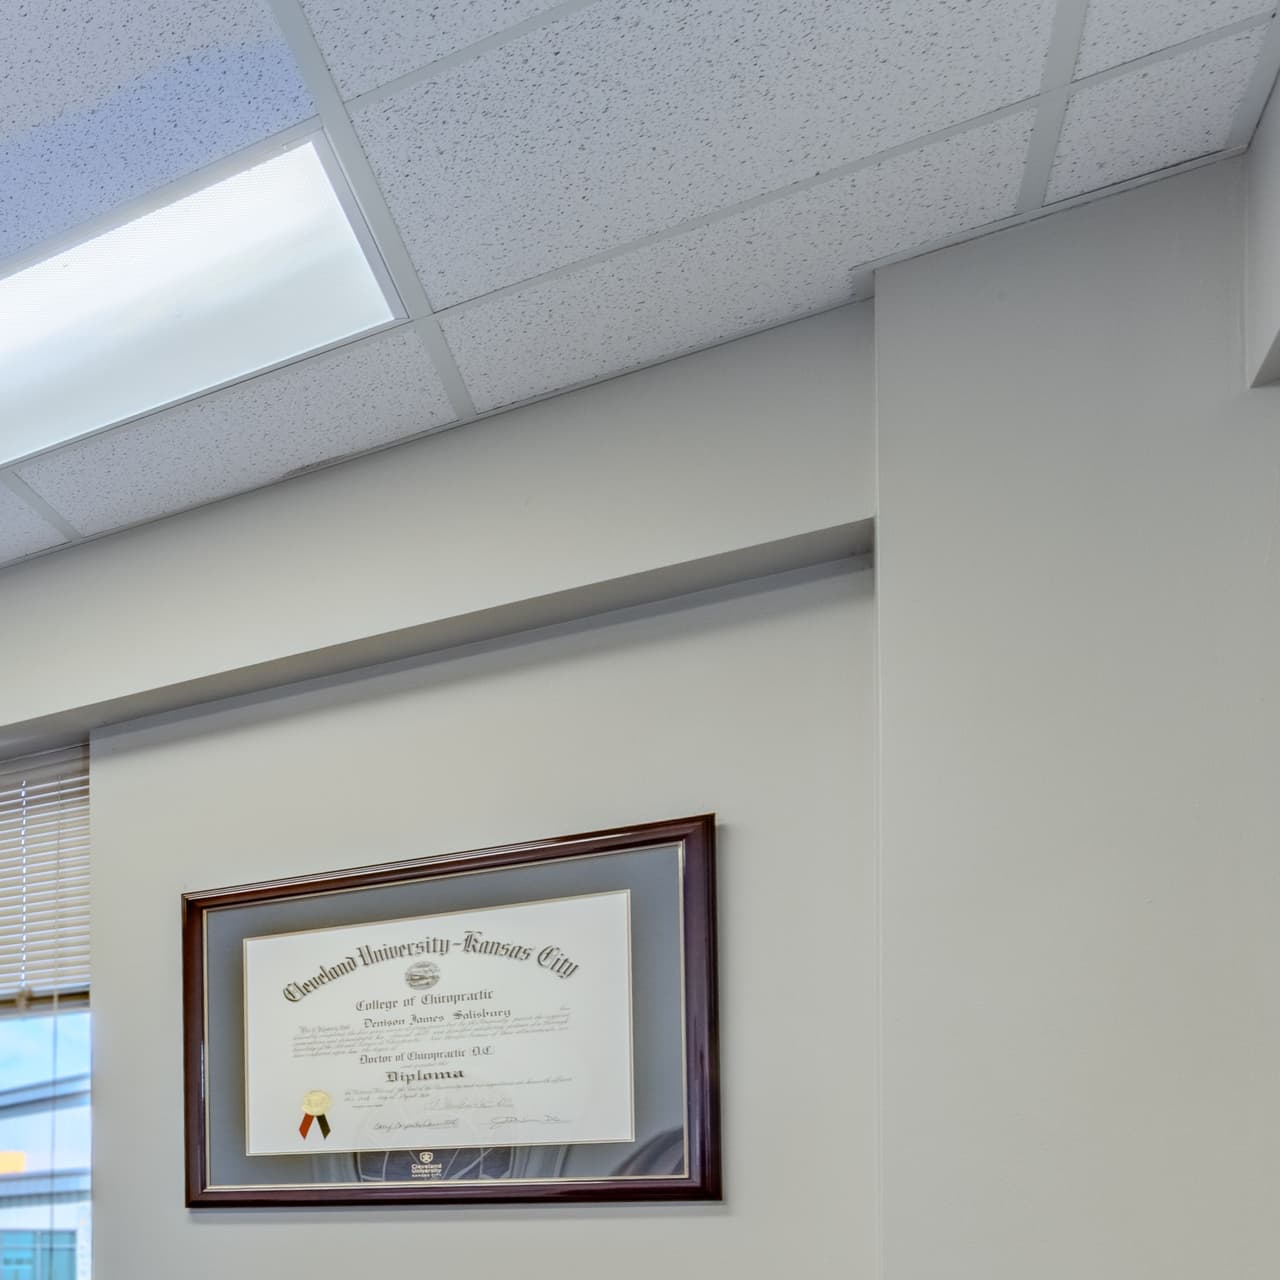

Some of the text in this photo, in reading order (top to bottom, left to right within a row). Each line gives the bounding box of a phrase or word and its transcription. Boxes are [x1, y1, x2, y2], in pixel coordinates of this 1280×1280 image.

[282, 956, 359, 1003] Cleveland
[536, 944, 580, 979] City
[355, 989, 494, 1012] College of Chiropractic
[362, 1017, 406, 1029] Denison
[408, 1014, 445, 1027] James
[452, 1008, 512, 1021] Salisbury
[359, 1053, 392, 1065] Doctor
[395, 1052, 405, 1063] of
[406, 1048, 466, 1063] Chiropractic
[384, 1068, 465, 1085] Diploma
